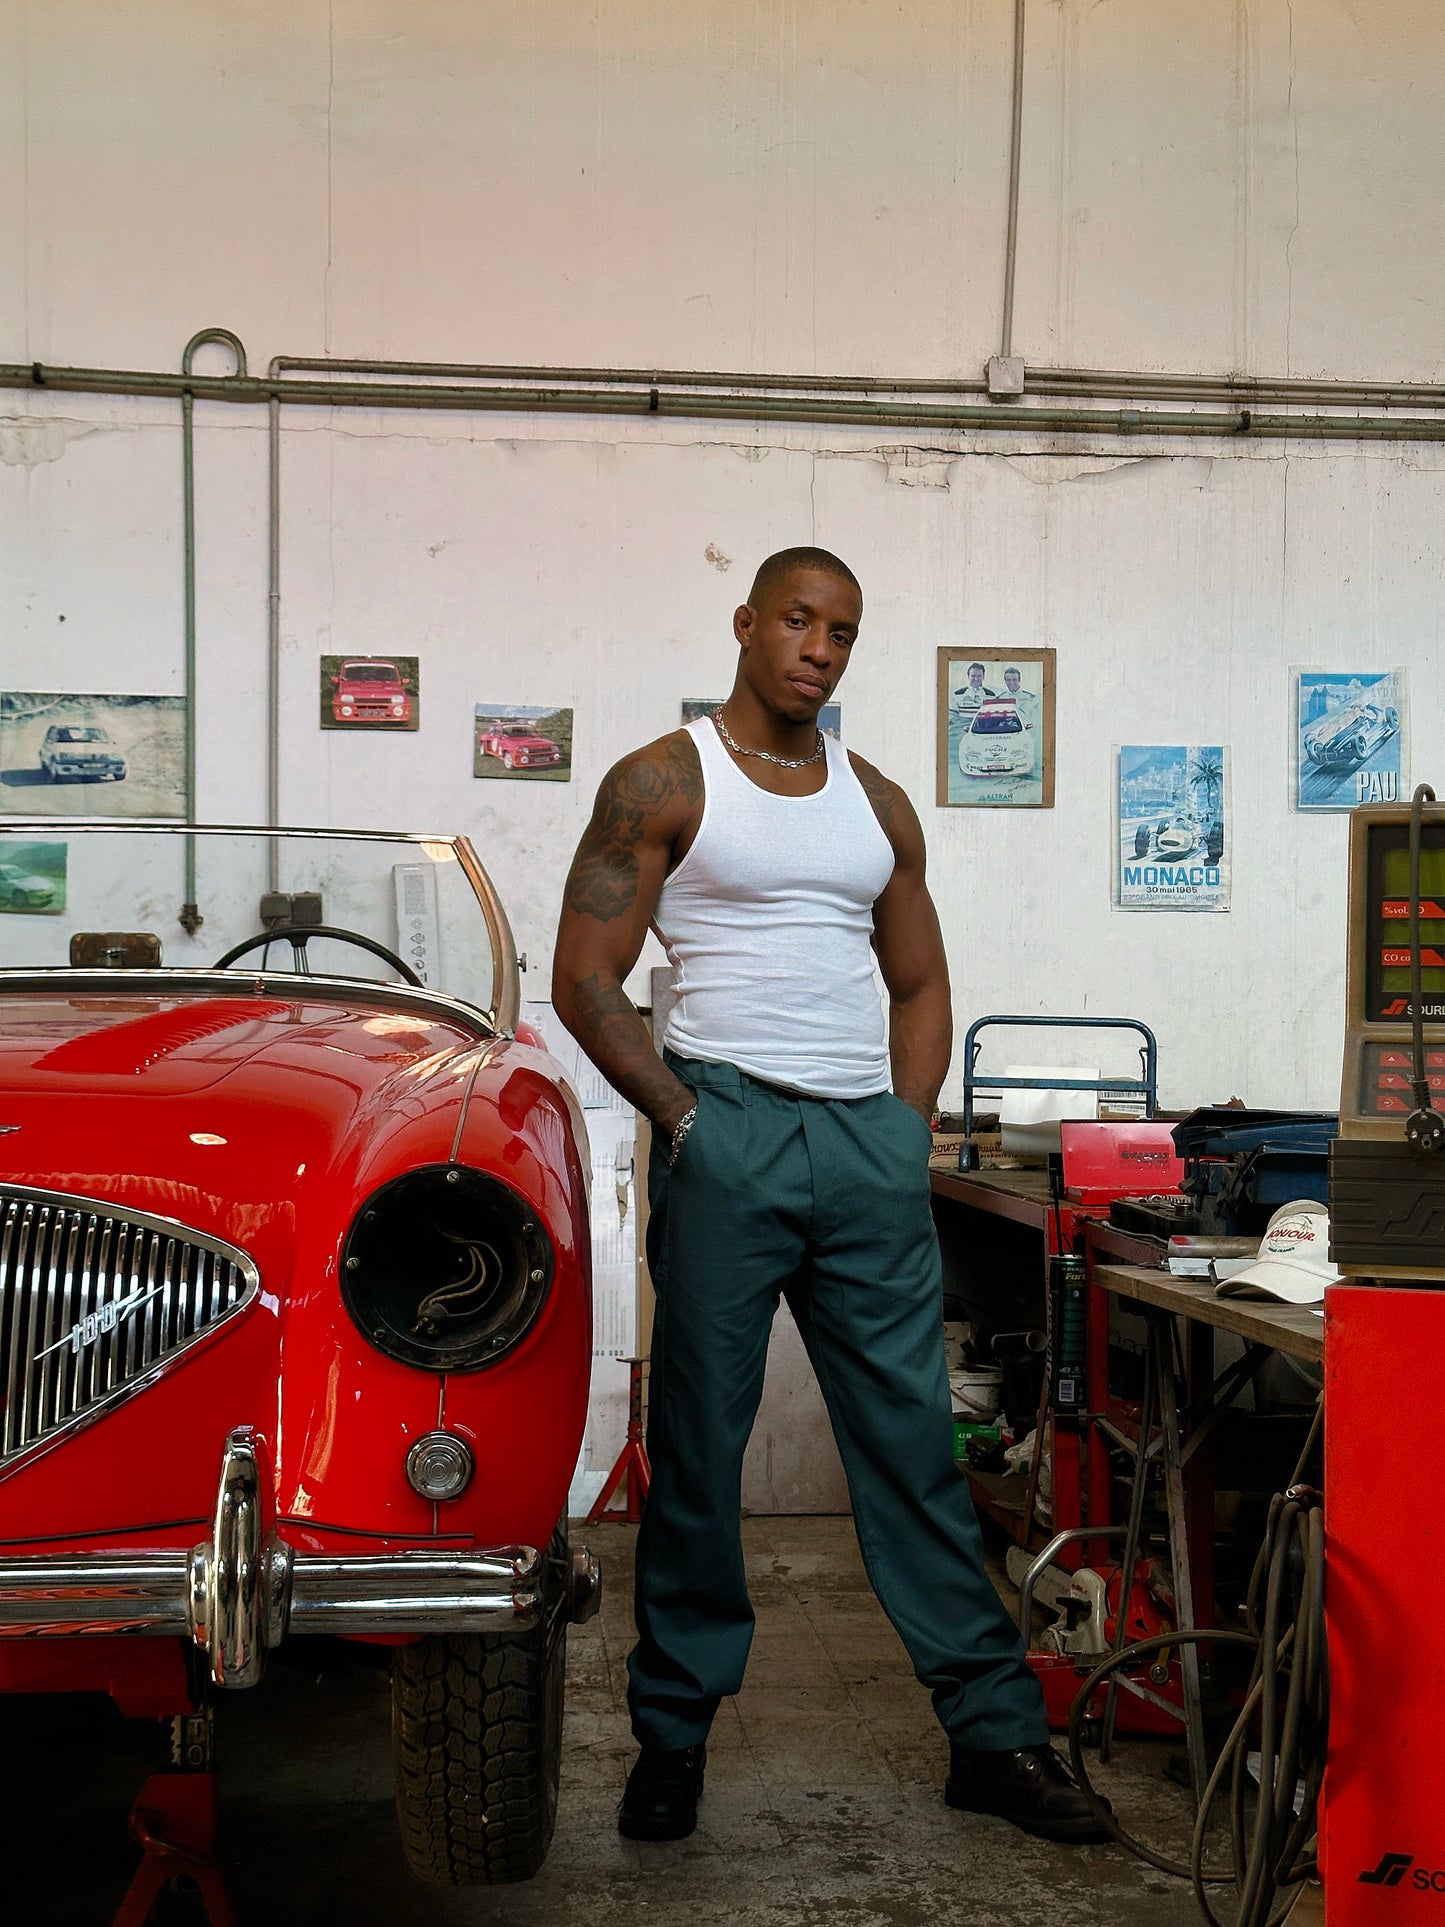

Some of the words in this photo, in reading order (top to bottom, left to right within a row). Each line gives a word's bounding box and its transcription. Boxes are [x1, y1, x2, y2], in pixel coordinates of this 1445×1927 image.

[1356, 770, 1398, 803] PAU
[1123, 866, 1220, 886] MONACO
[1383, 953, 1398, 962] CO
